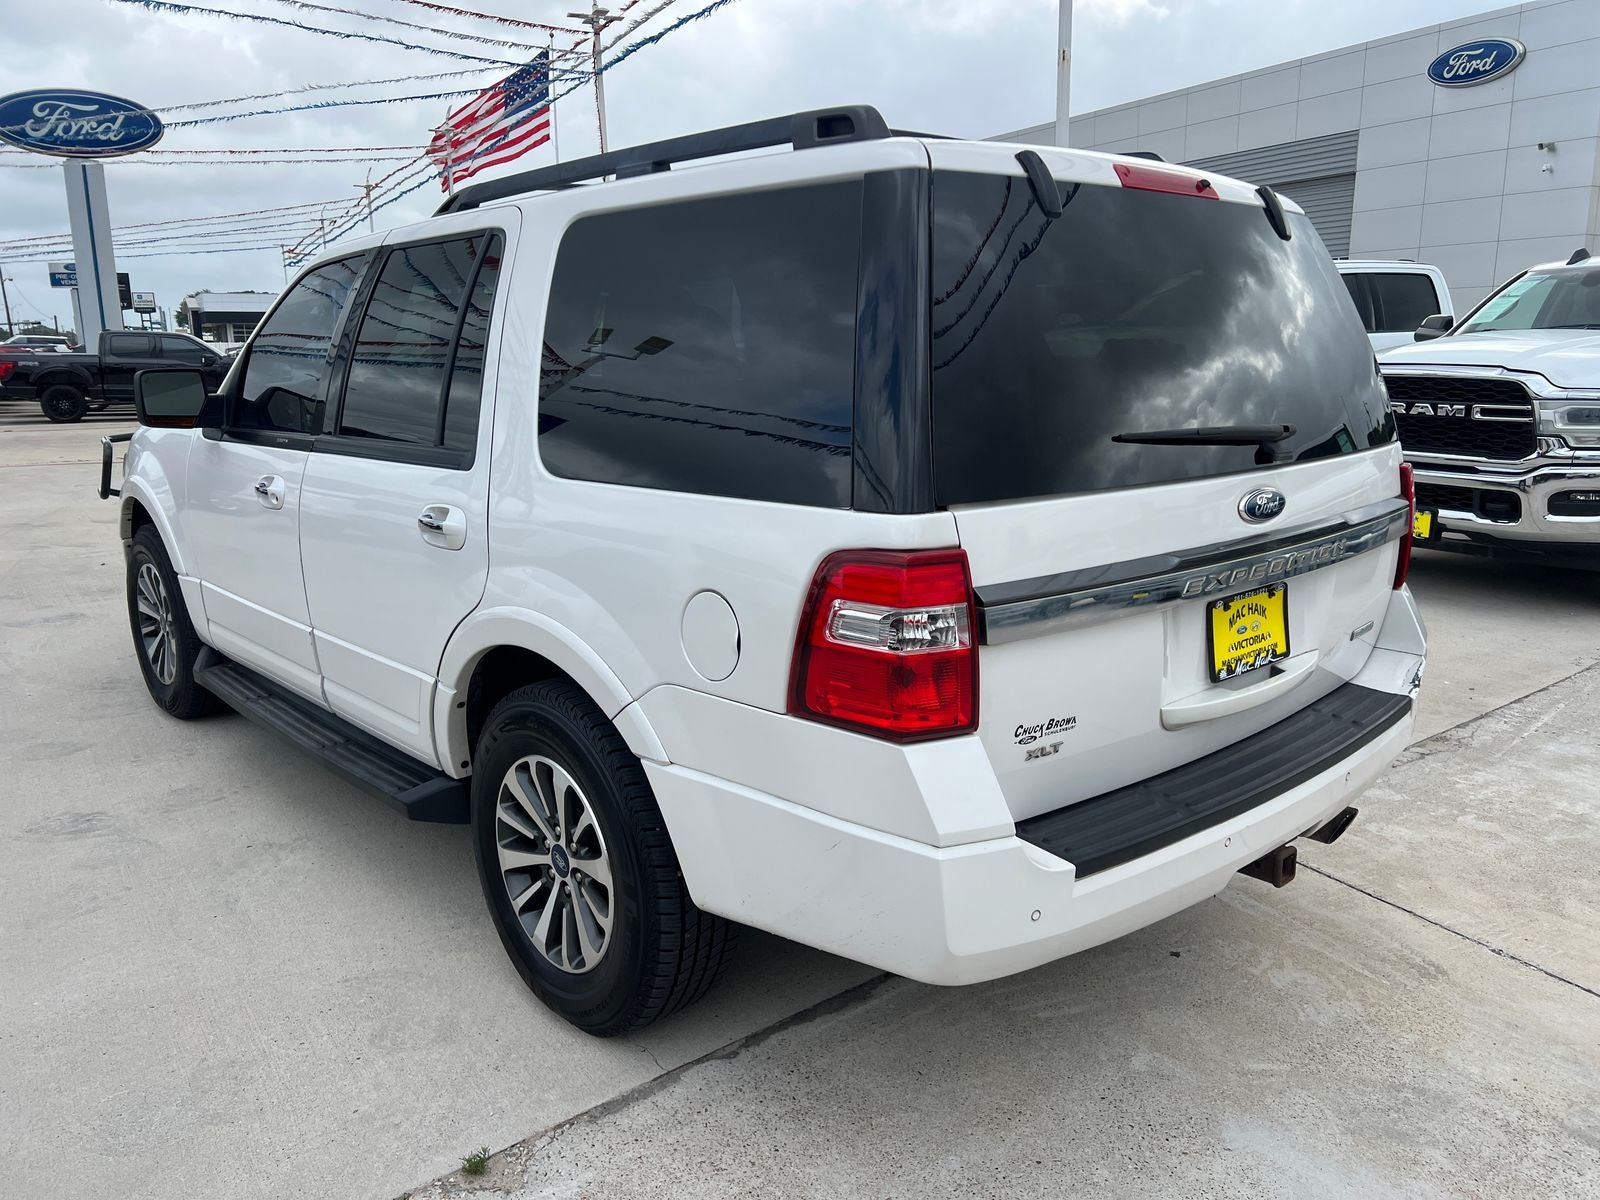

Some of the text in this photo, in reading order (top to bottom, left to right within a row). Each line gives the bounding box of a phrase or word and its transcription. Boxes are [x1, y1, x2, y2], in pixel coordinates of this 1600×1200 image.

[1443, 48, 1498, 79] Ford
[24, 100, 126, 141] Ford
[1389, 402, 1466, 417] RAM
[1255, 492, 1280, 515] Ford
[1181, 539, 1348, 598] EXPEDITION
[1228, 604, 1246, 632] MAC
[1247, 602, 1268, 620] HAIK
[1233, 633, 1267, 652] VICTORIA
[1234, 649, 1275, 675] Mac Haik
[1024, 741, 1064, 761] XLT
